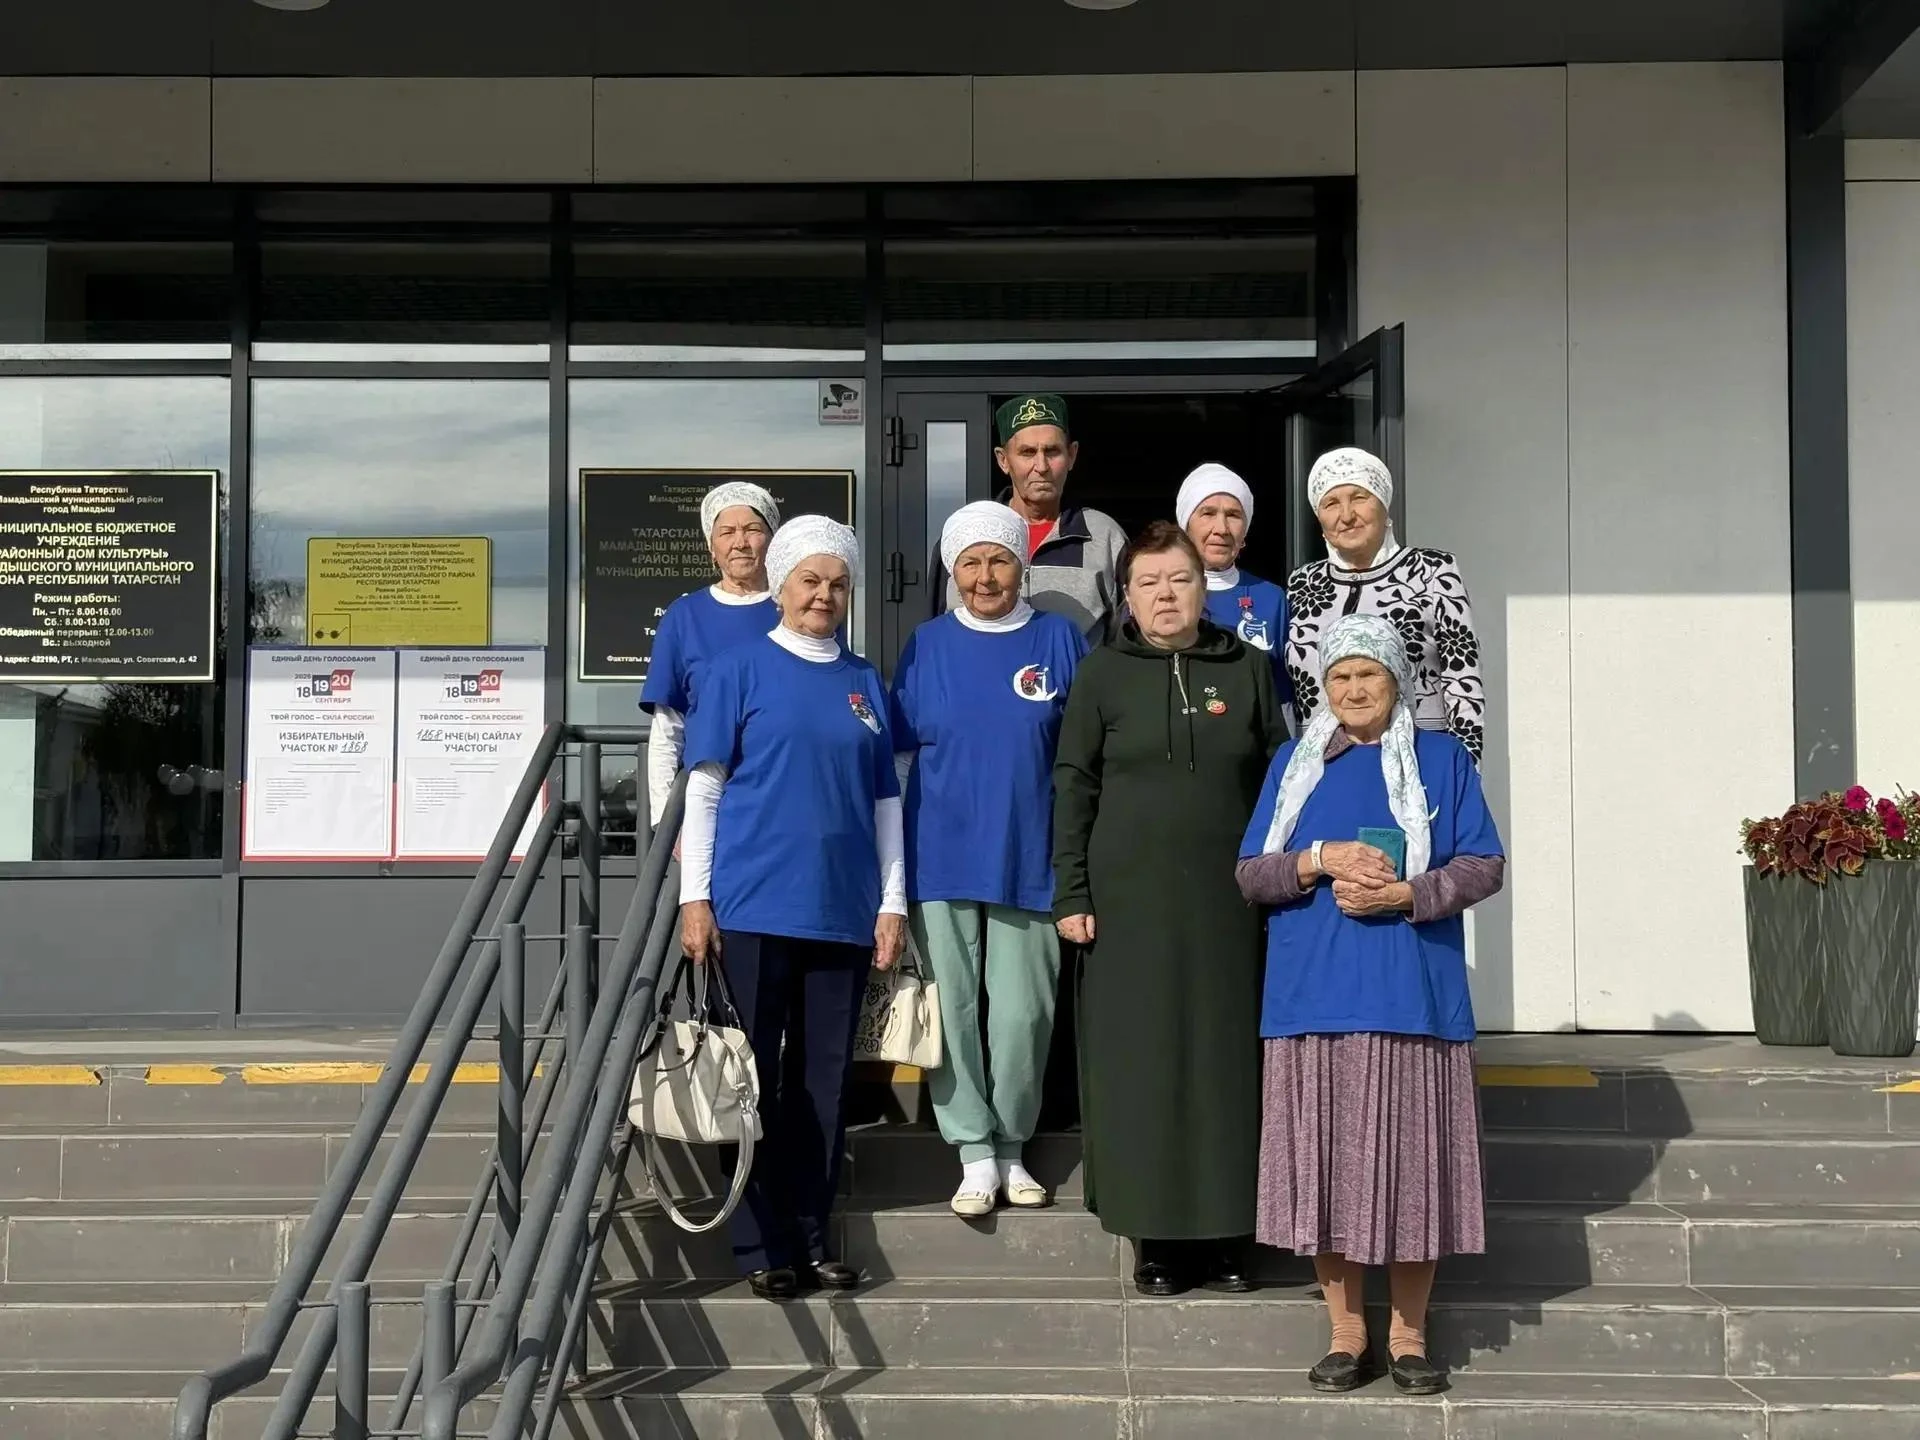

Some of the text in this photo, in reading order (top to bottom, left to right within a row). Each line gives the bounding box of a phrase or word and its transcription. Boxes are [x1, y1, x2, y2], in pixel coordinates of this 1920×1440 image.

[30, 485, 129, 495] Республика Татарстан
[662, 485, 707, 494] Татарстан
[61, 495, 135, 505] муниципальный
[136, 495, 164, 505] район
[43, 505, 116, 514] город Мамадыш
[95, 522, 177, 535] БЮДЖЕТНОЕ
[631, 528, 699, 538] ТАТАРСТАН
[36, 535, 121, 547] УЧРЕЖДЕНИЕ
[600, 541, 667, 552] МАМАДЫШ
[66, 548, 96, 560] ДОМ
[98, 548, 169, 560] КУЛЬТУРЫ»
[631, 552, 679, 564] «РАЙОН
[75, 561, 195, 574] МУНИЦИПАЛЬНОГО
[596, 567, 680, 579] МУНИЦИПАЛЬ
[28, 574, 110, 585] РЕСПУБЛИКИ
[111, 574, 182, 585] ТАТАРСТАН
[34, 592, 121, 605] Режим работы:
[44, 617, 111, 626] Сб.: 8.00-13.00
[63, 638, 111, 648] выходной
[297, 674, 350, 698] 18 19 20
[446, 674, 499, 698] 18 19 20
[270, 712, 290, 721] ТВОЙ
[291, 713, 315, 721] ГОЛОС
[322, 713, 342, 721] СИЛА
[419, 712, 439, 721] ТВОЙ
[440, 713, 464, 721] ГОЛОС
[471, 713, 491, 721] СИЛА
[279, 731, 365, 741] ИЗБИРАТЕЛЬНЫЙ
[444, 732, 480, 742] НЧЕ(Ы)
[481, 730, 523, 740] САЙЛАУ
[280, 743, 326, 752] УЧАСТОК
[328, 743, 339, 752] №
[444, 743, 498, 752] УЧАСТОГЫ
